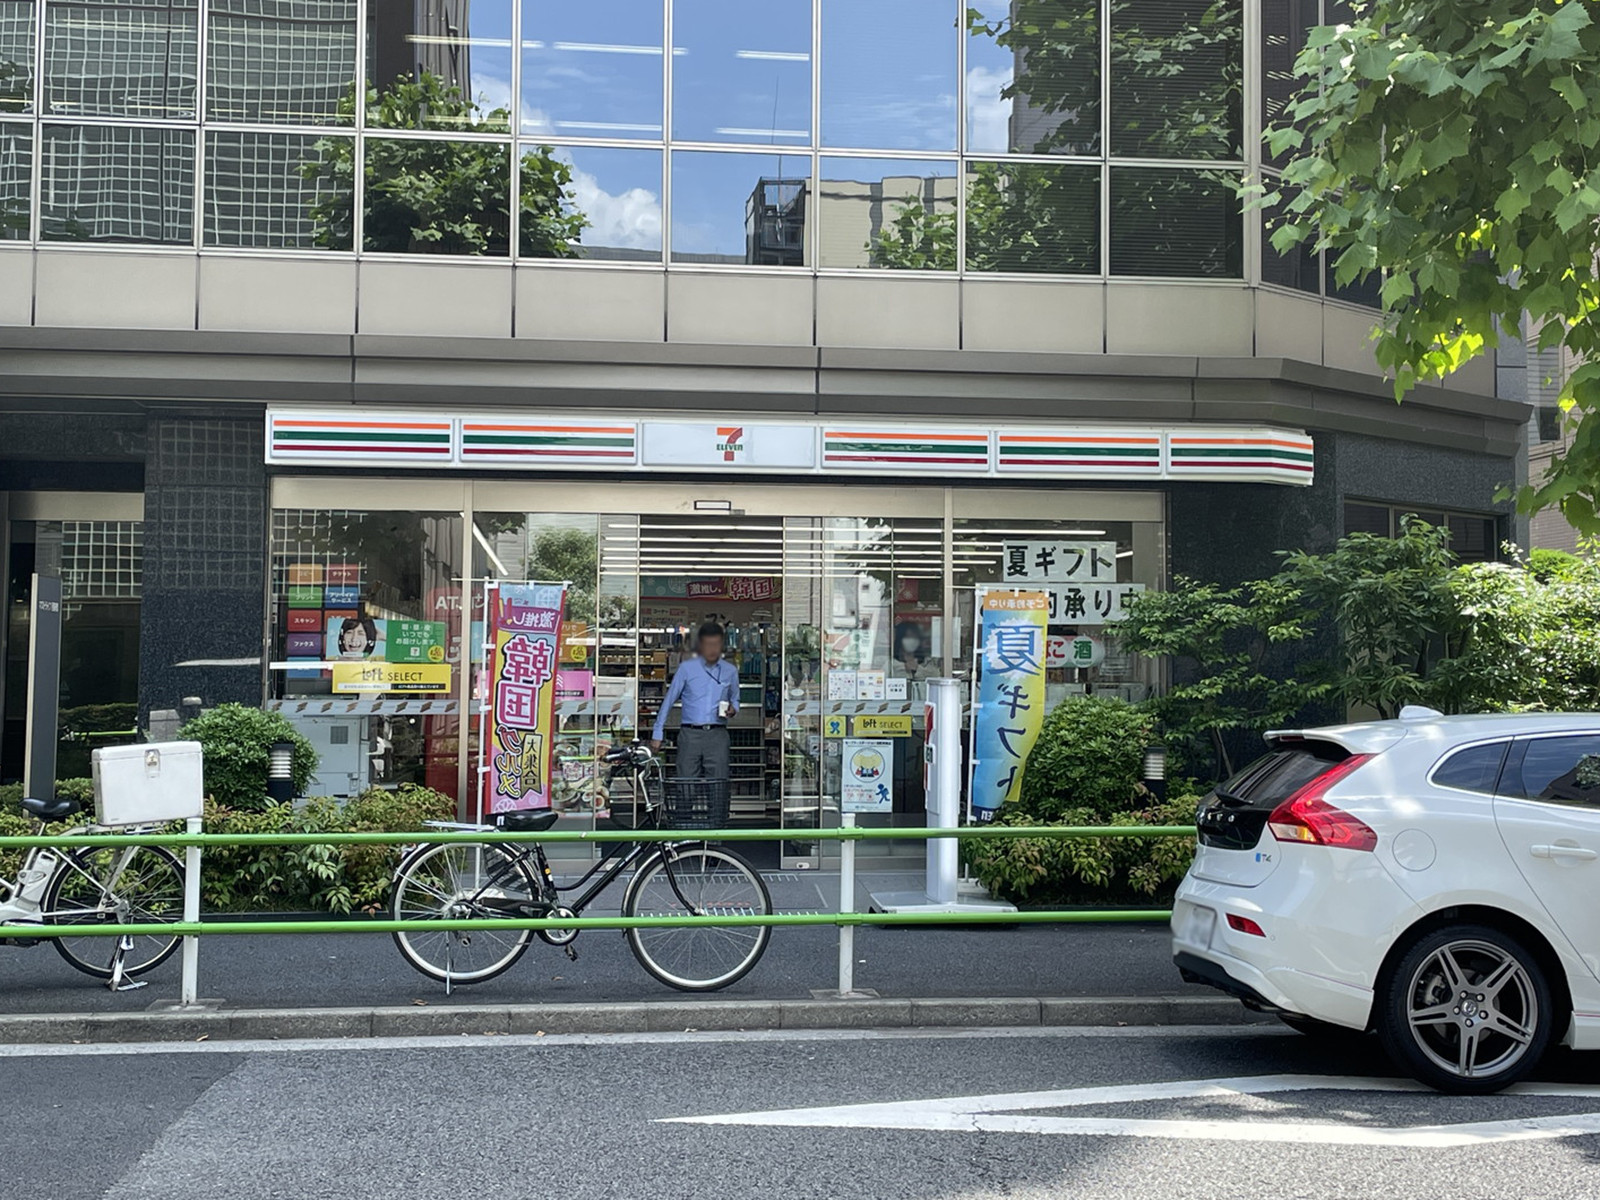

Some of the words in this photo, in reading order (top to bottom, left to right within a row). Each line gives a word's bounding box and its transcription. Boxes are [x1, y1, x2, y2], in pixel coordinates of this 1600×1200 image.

[1006, 545, 1113, 577] 夏ギフト
[730, 577, 773, 600] 韓国
[402, 631, 430, 639] いつでも
[1073, 640, 1093, 659] 酒
[387, 672, 424, 682] SELECT
[879, 721, 903, 729] SELECT
